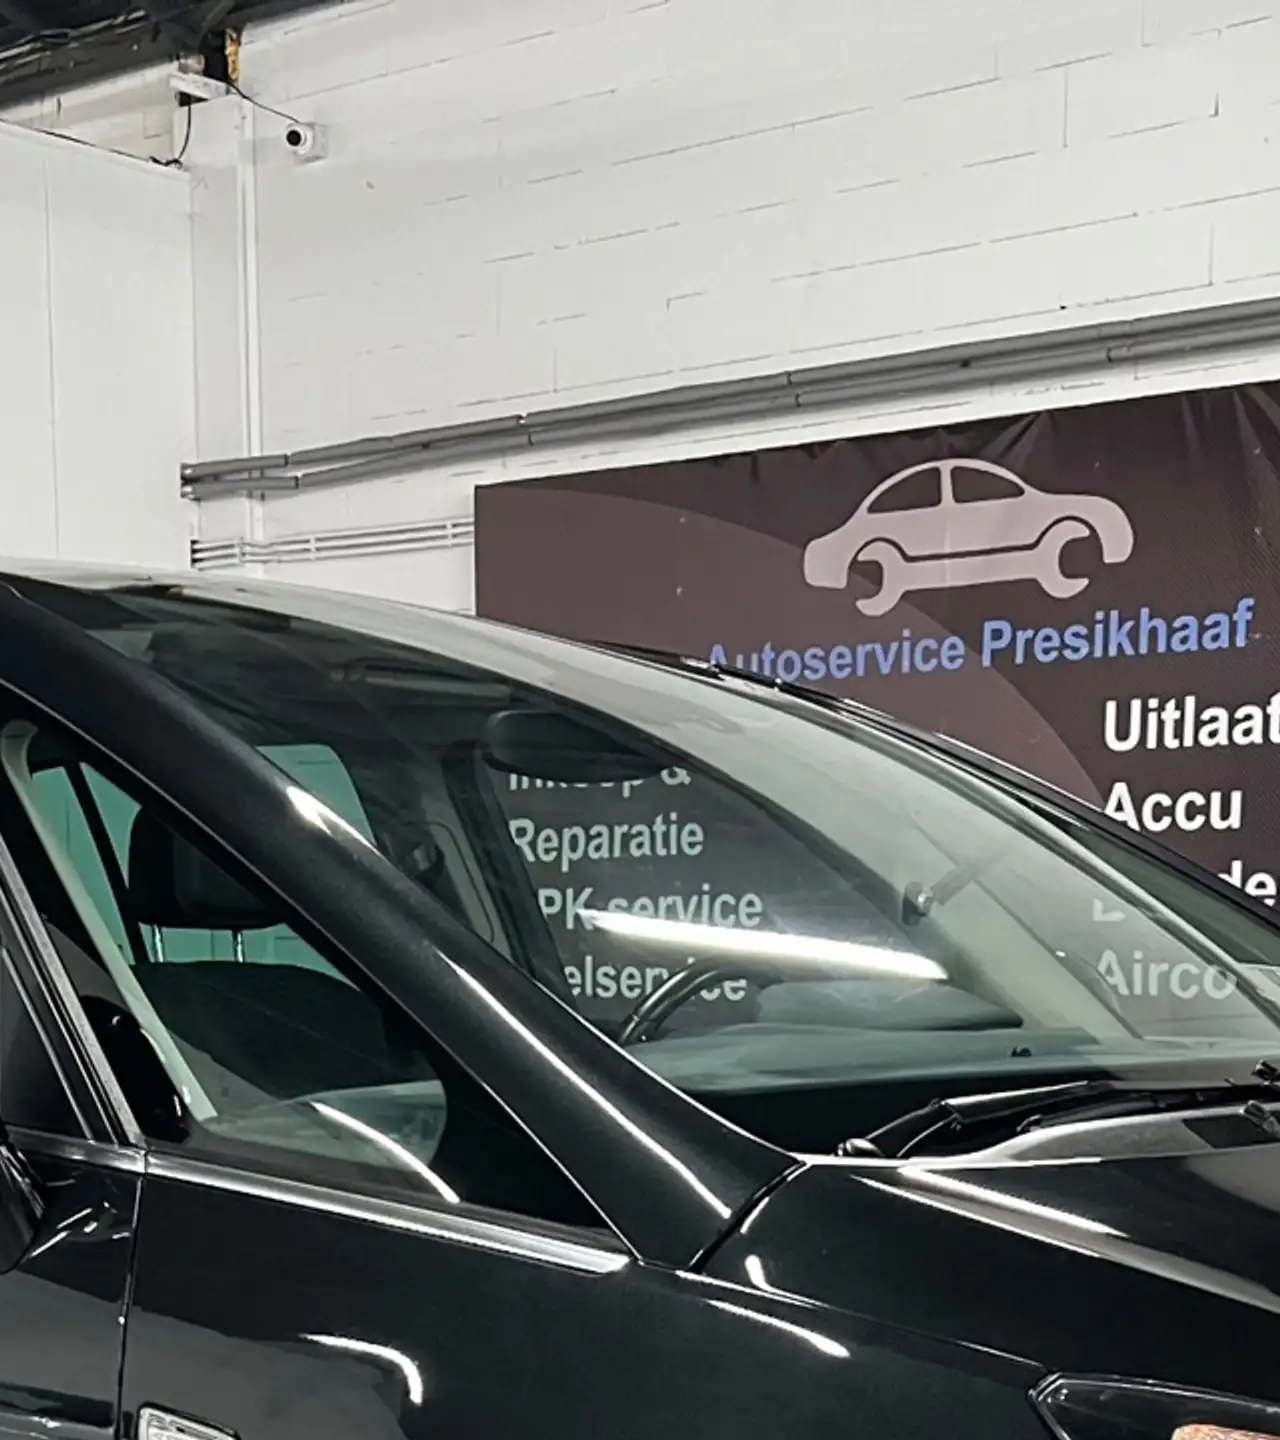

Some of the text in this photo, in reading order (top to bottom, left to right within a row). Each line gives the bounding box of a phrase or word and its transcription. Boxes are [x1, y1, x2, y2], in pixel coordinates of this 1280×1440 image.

[710, 597, 1256, 682] Autoservice Presikhaaf
[1103, 782, 1243, 832] Accu
[508, 812, 705, 873] Reparatie
[537, 887, 597, 931] PK
[1097, 949, 1238, 999] Airco
